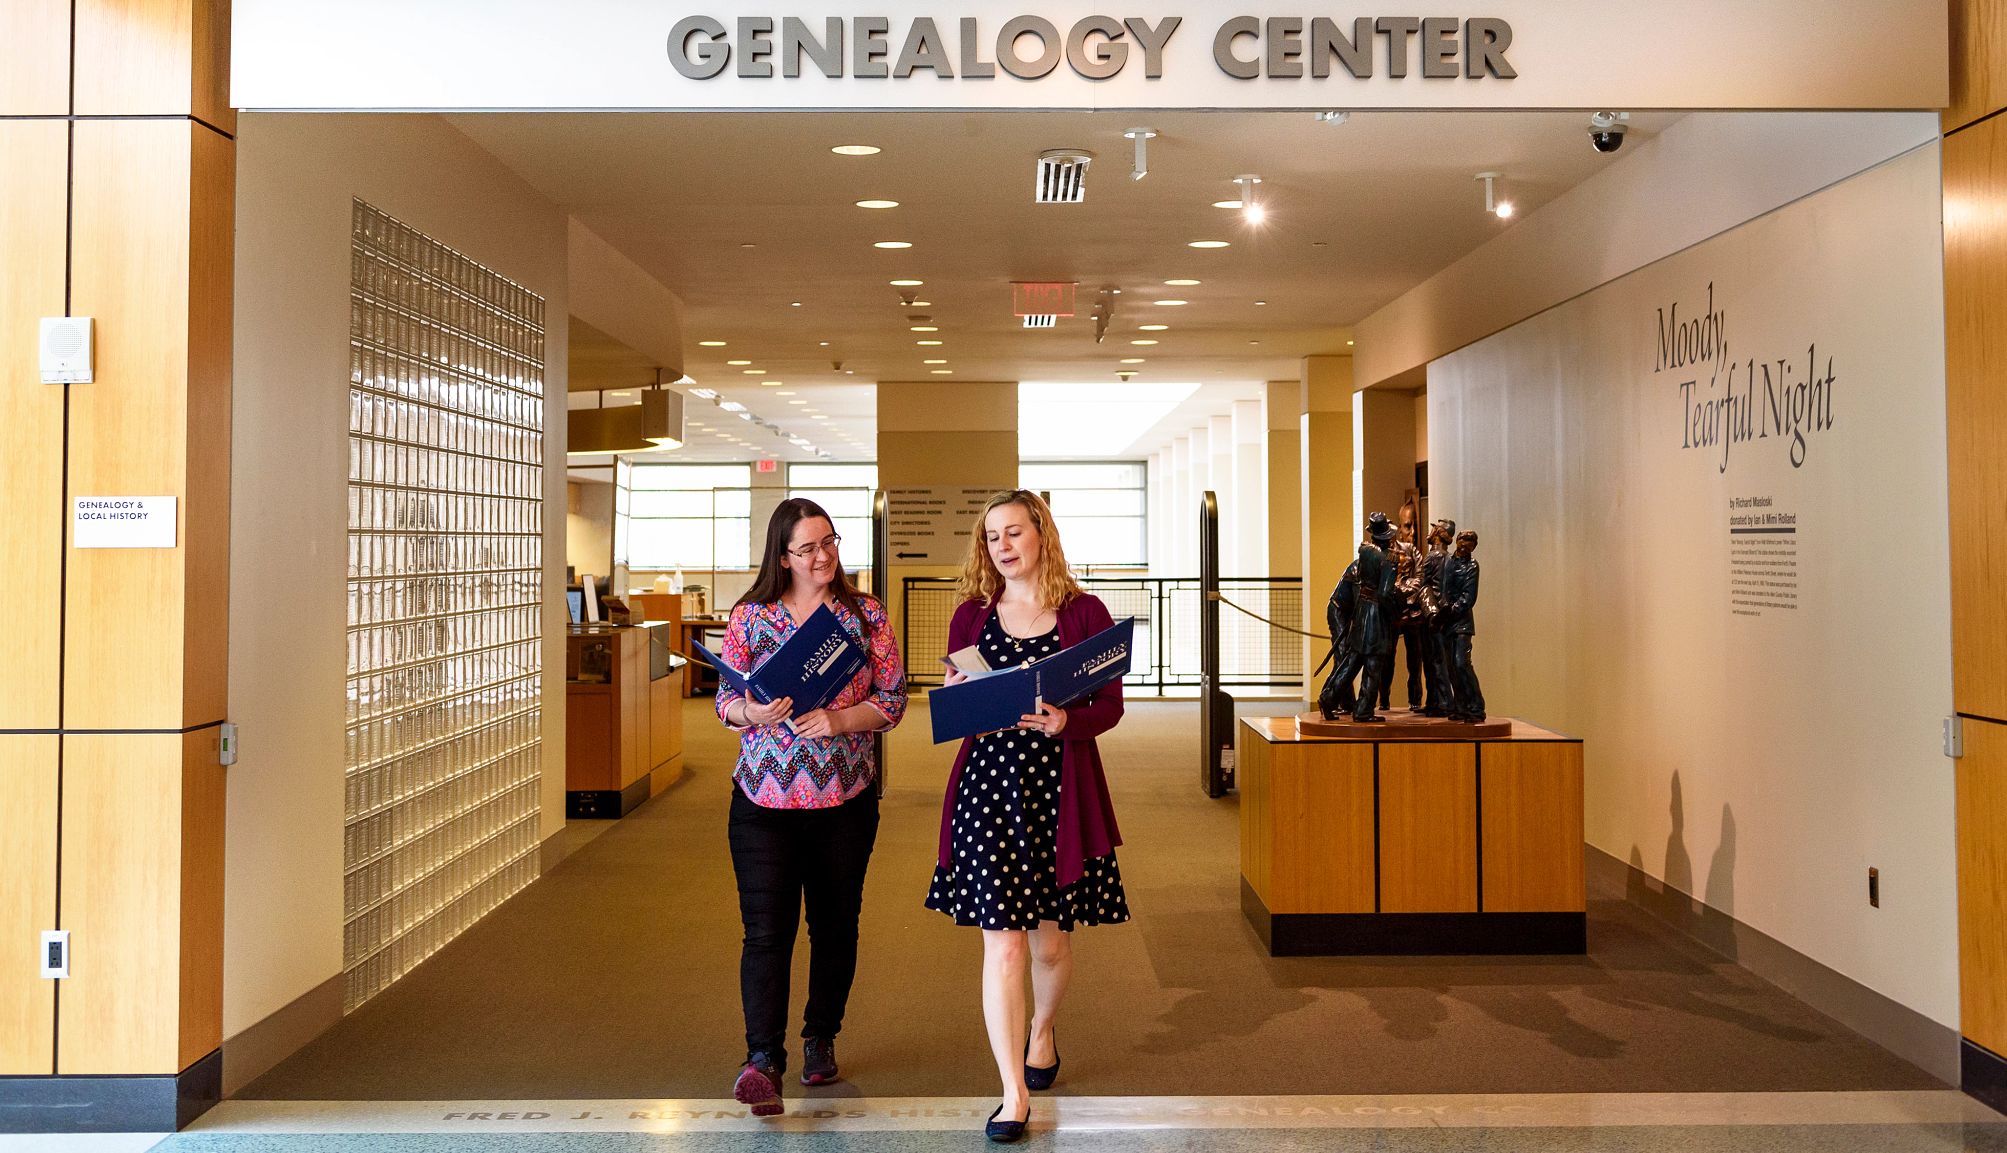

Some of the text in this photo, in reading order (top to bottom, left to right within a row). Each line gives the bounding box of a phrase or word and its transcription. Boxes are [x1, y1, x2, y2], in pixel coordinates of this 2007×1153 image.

[666, 14, 1519, 81] GENEALOGY CENTER
[1654, 280, 1728, 388] Moody,
[1679, 342, 1836, 474] Tearful Night
[78, 501, 144, 509] GENEALOGY &
[78, 512, 149, 520] LOCAL HISTORY
[1729, 497, 1735, 510] by
[1735, 497, 1752, 508] Richard
[1730, 514, 1747, 526] donated
[1747, 514, 1753, 527] by
[1766, 513, 1778, 524] Mimi
[801, 634, 843, 682] HISTORY
[803, 629, 838, 670] FAMILY
[1073, 645, 1127, 678] HISTORY
[1082, 640, 1128, 668] FAMILY
[442, 1111, 552, 1121] FRED
[570, 1111, 604, 1121] J.
[627, 1109, 867, 1120] REYNLDS
